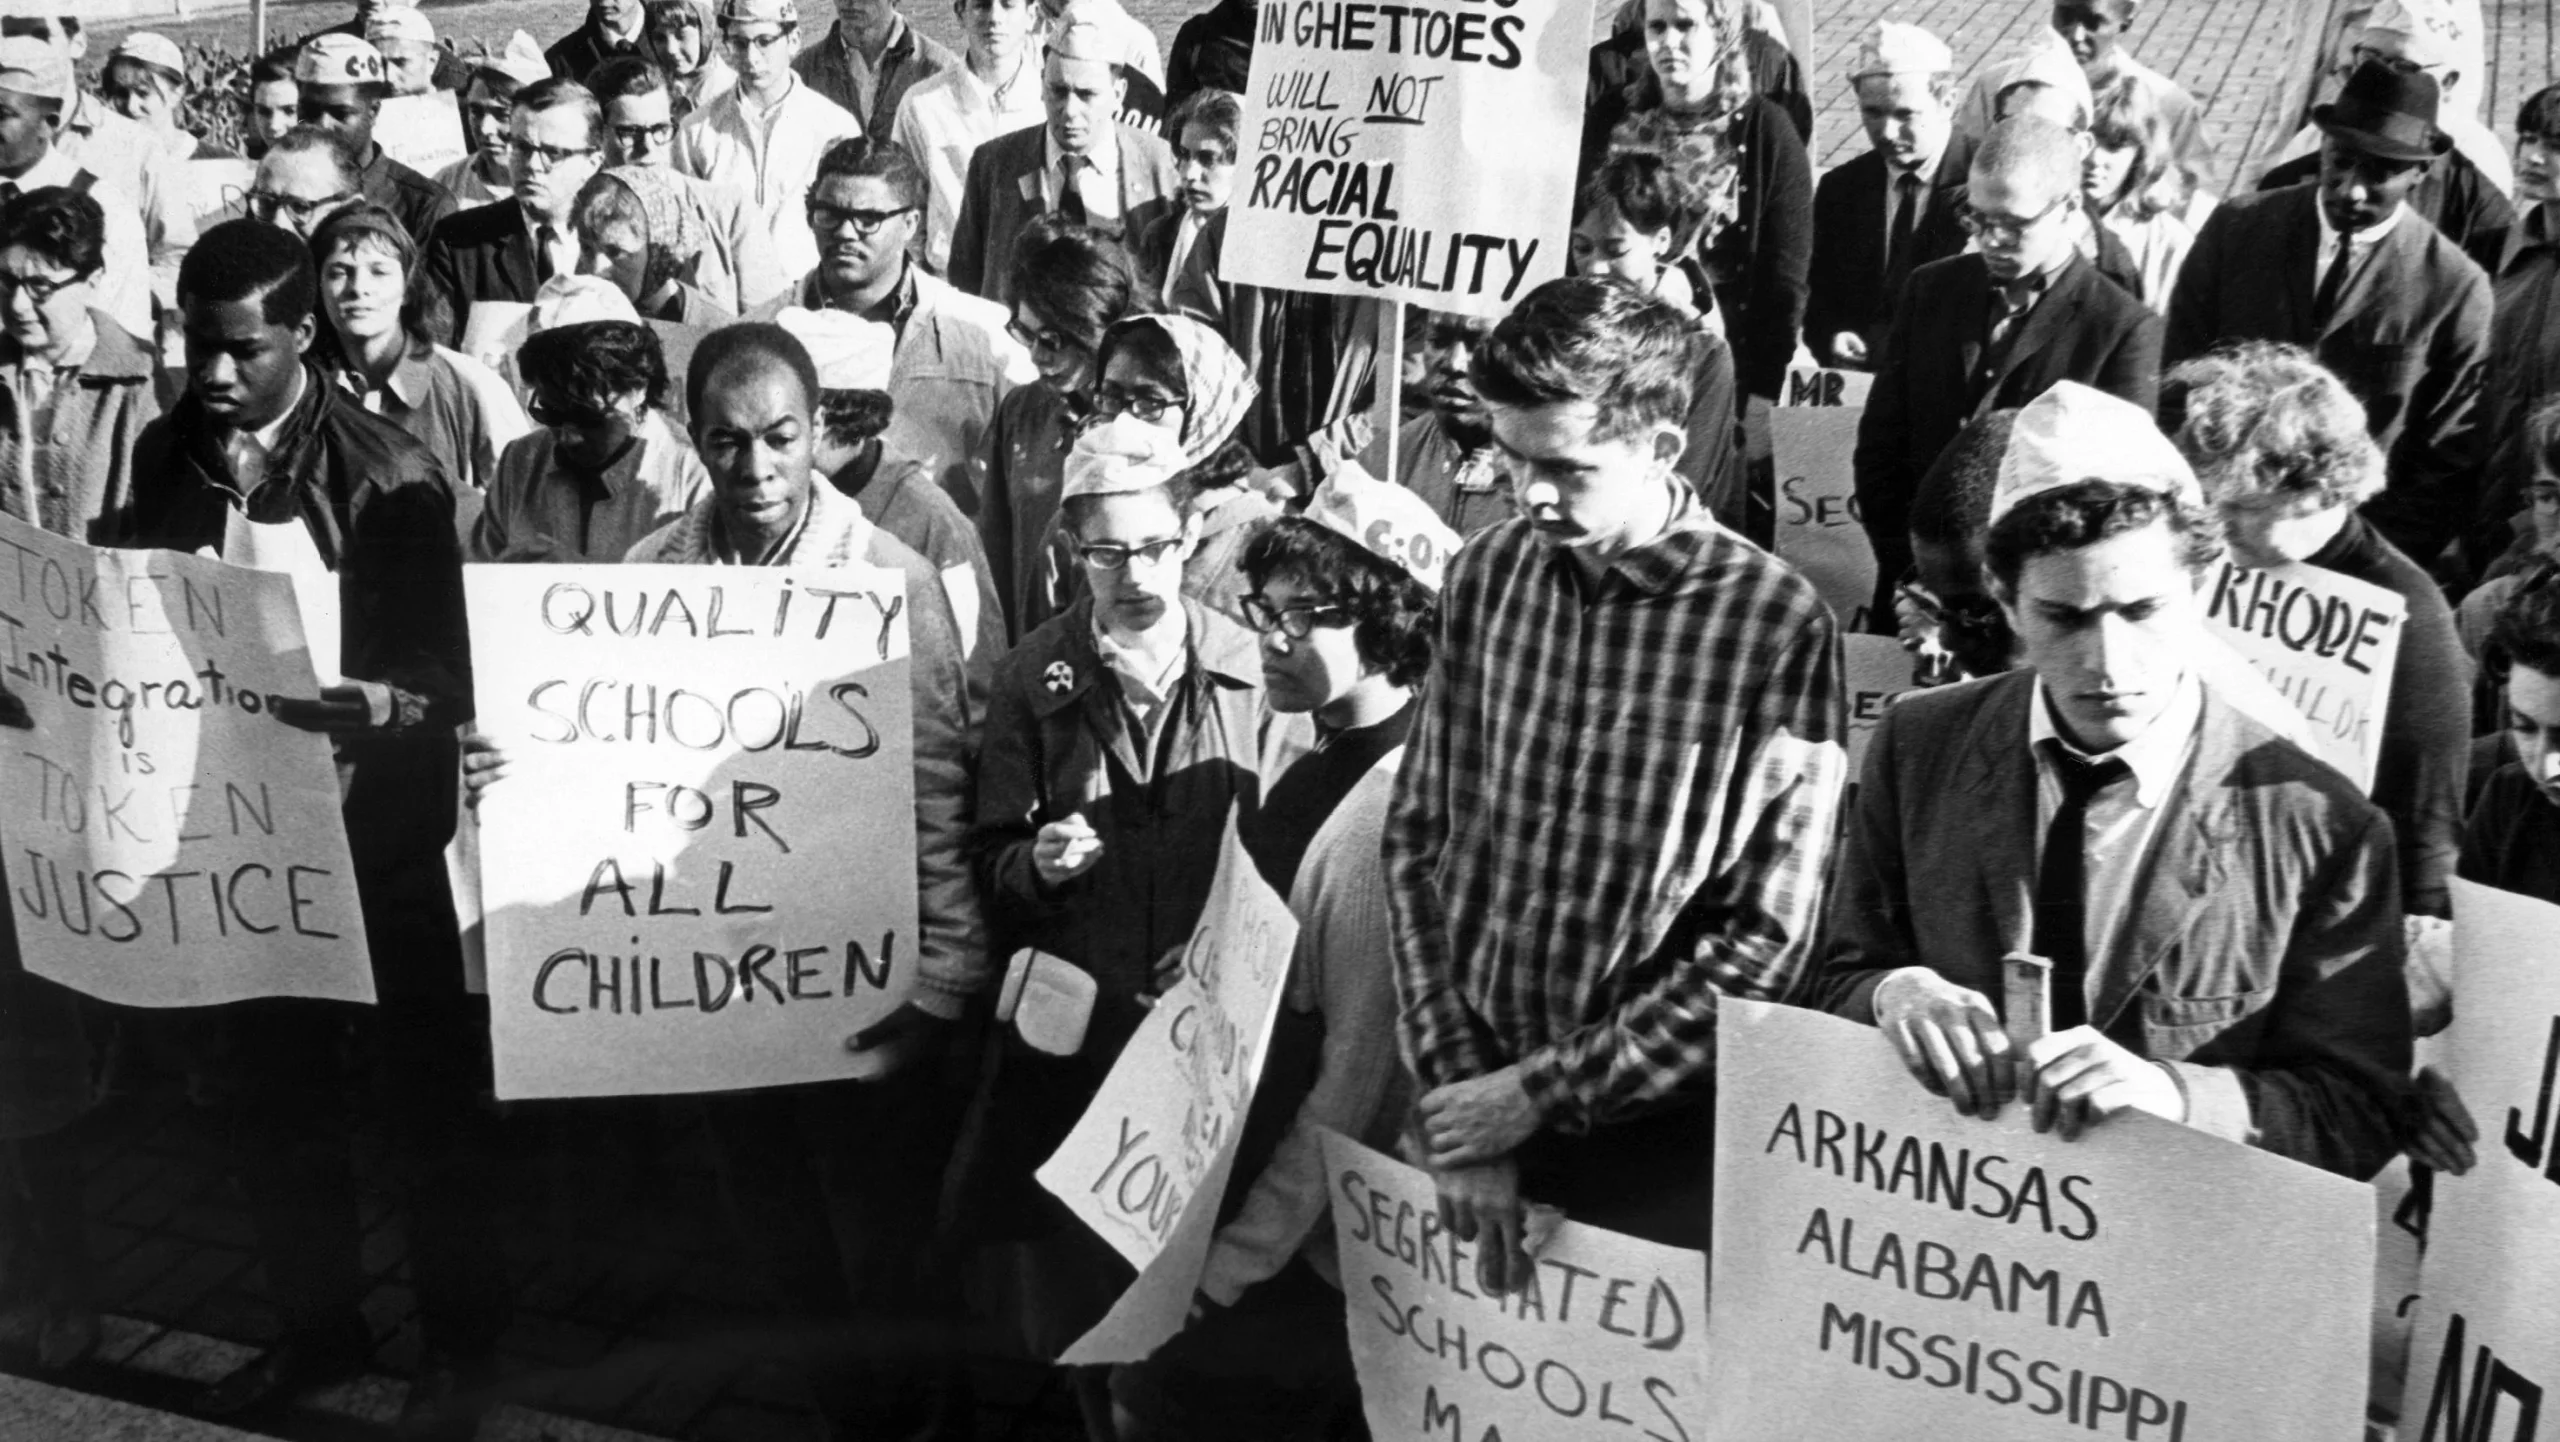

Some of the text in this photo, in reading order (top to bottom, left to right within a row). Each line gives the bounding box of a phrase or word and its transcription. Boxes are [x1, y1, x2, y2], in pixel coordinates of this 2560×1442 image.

[1260, 2, 1526, 70] IN GHETTOES
[1258, 116, 1360, 159] BRING
[1266, 70, 1444, 123] WILL NOT
[1248, 153, 1399, 222] RACIAL
[1304, 218, 1540, 302] EQUALITY
[1789, 369, 1847, 407] MR
[0, 536, 225, 638] TOKEN
[2207, 562, 2390, 676] RHODE
[527, 676, 881, 769] SCHOOLS
[2248, 658, 2372, 756] HILD
[22, 752, 274, 843] TOKEN
[122, 752, 156, 775] is
[624, 780, 791, 854] FOR
[19, 849, 340, 945] JUSTICE
[580, 857, 774, 917] ALL
[2504, 1014, 2560, 1188] J
[1765, 1102, 2099, 1242] ARKANSAS
[1797, 1207, 2111, 1338] ALABAMA
[1370, 1275, 1692, 1442] SCHOOLS
[1820, 1302, 2188, 1442] MISSISSIPPI
[1424, 1384, 1502, 1442] M
